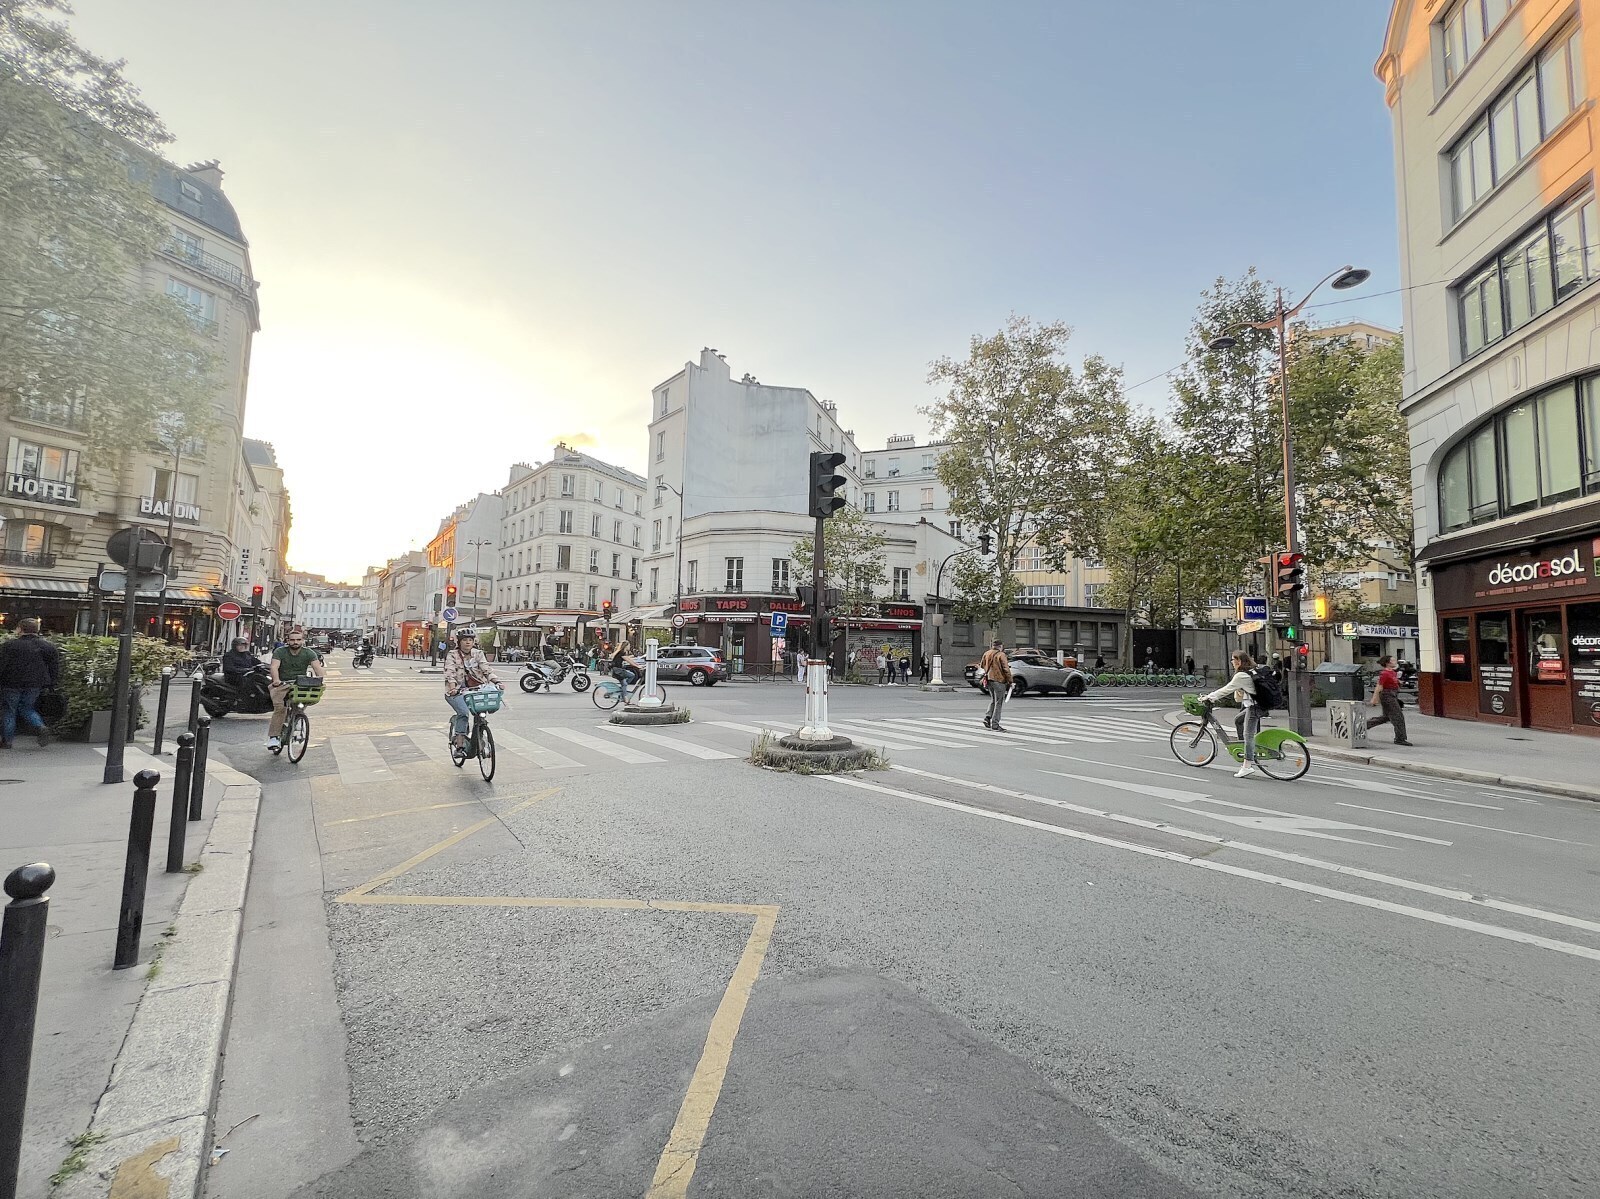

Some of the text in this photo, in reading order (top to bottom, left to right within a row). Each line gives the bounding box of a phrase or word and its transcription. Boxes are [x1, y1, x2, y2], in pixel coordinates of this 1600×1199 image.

[8, 475, 78, 502] HOTEL
[141, 497, 200, 521] BAUDIN
[240, 548, 250, 575] HOTEL
[1489, 548, 1585, 585] décorasol
[680, 601, 699, 610] LINOS
[716, 600, 748, 609] TAPIS
[769, 602, 805, 611] DALLES
[889, 608, 915, 617] LINOS
[1244, 605, 1266, 614] TAXIS
[776, 615, 784, 625] P
[1370, 627, 1397, 636] PARKING
